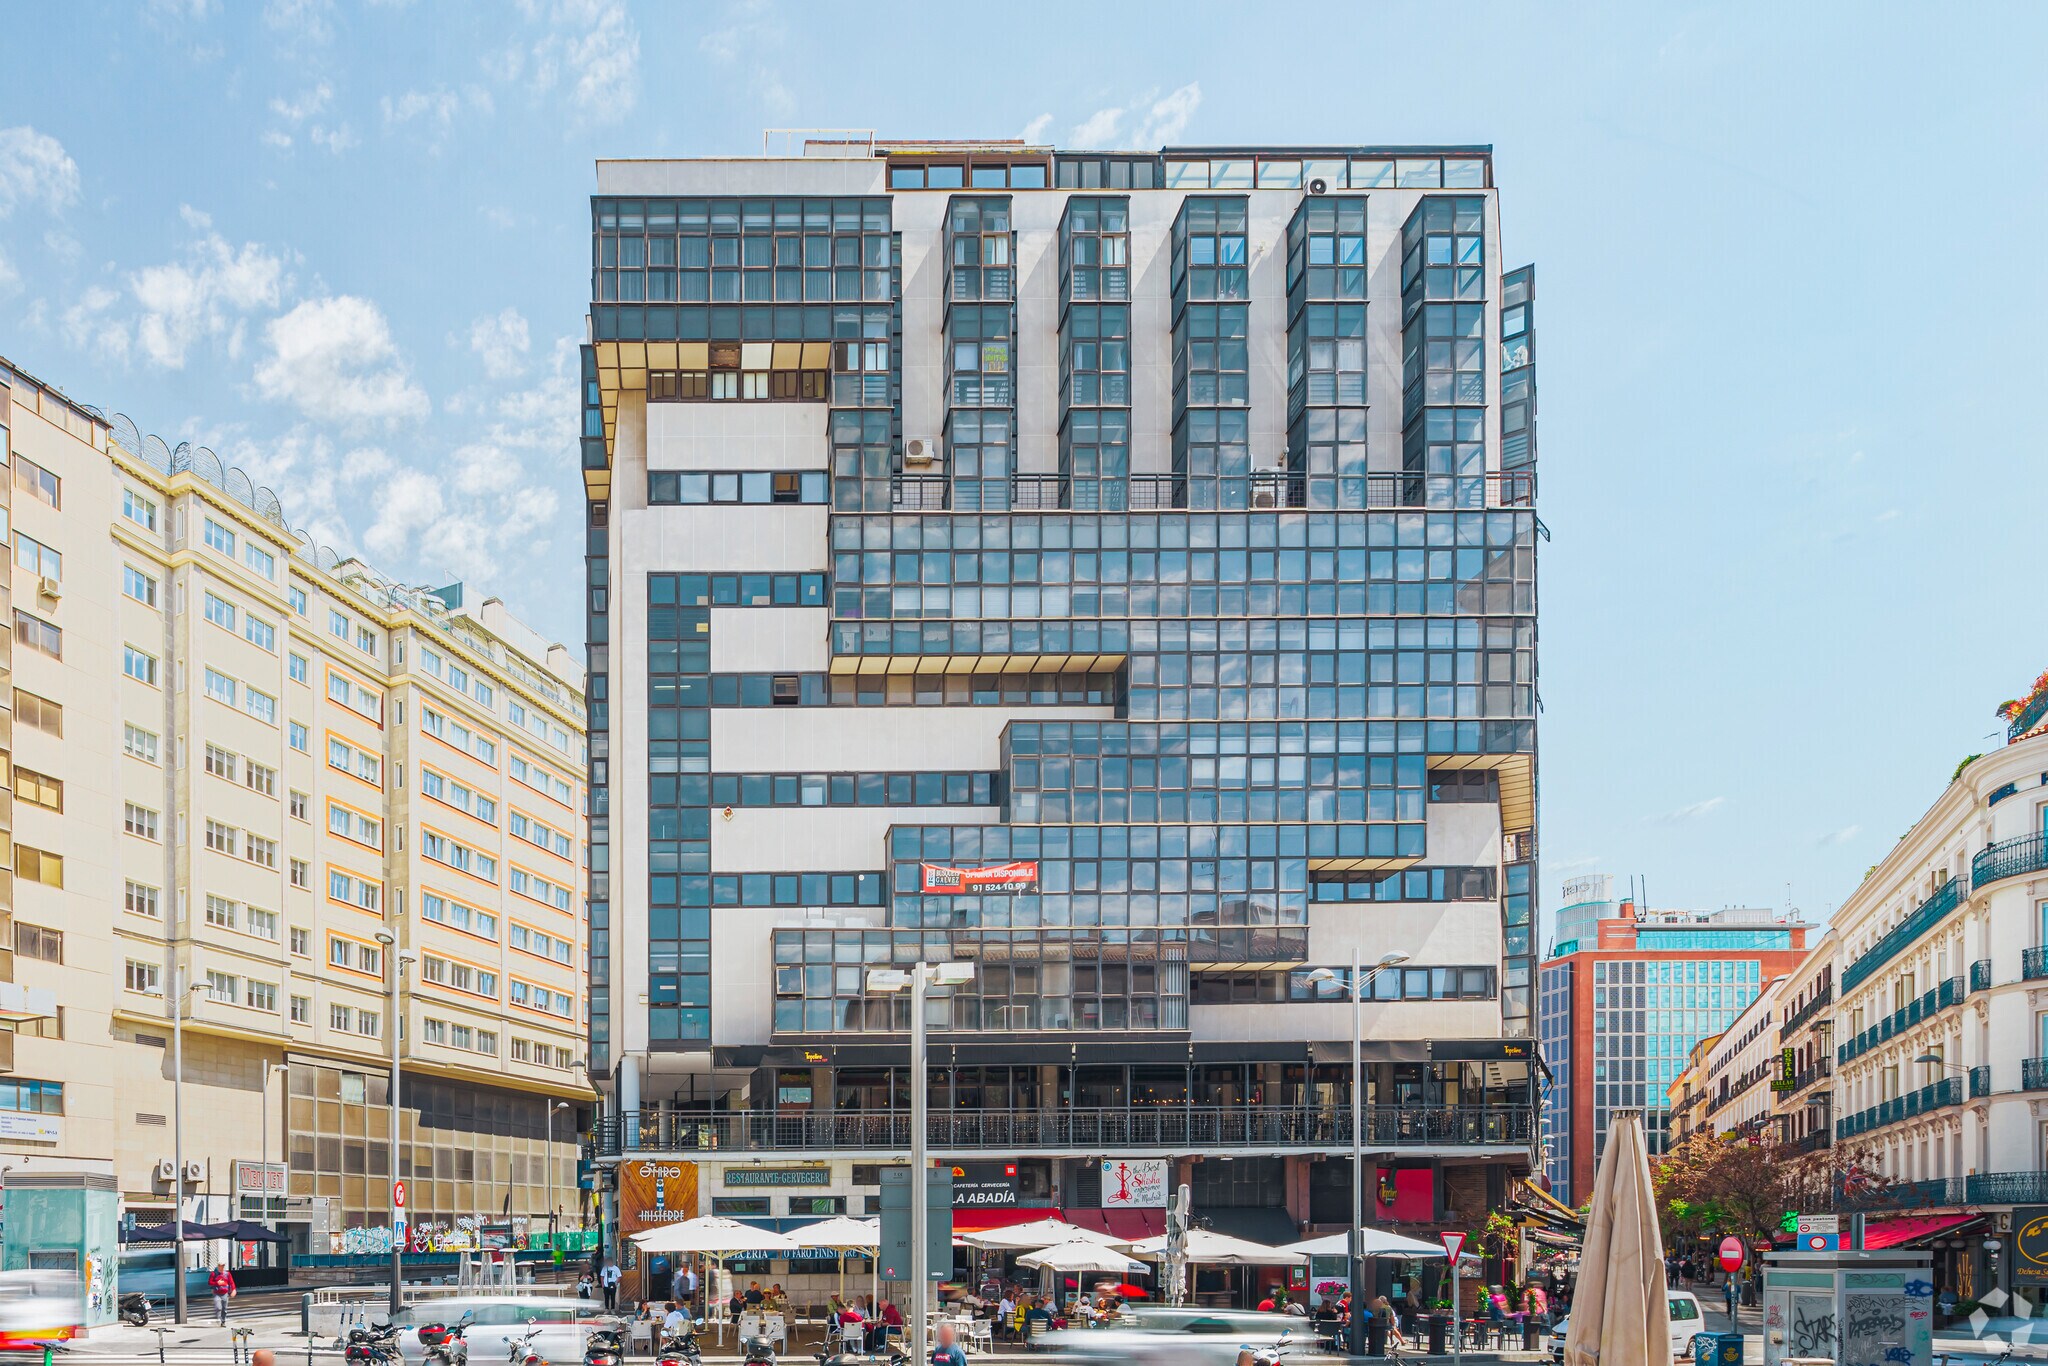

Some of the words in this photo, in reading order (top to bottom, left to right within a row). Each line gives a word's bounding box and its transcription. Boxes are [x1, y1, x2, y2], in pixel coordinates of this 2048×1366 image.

[993, 868, 1034, 878] DISPONIBLE
[972, 884, 983, 892] 91
[985, 883, 1001, 891] 524
[1003, 882, 1012, 890] 10
[1014, 882, 1026, 890] 99
[1784, 1049, 1793, 1079] HOSTAL
[1142, 1161, 1160, 1173] Best
[1131, 1171, 1161, 1187] Shisha
[966, 1189, 1016, 1204] ABADÍA
[792, 1250, 812, 1258] FARO
[2016, 1267, 2041, 1276] Dehesa
